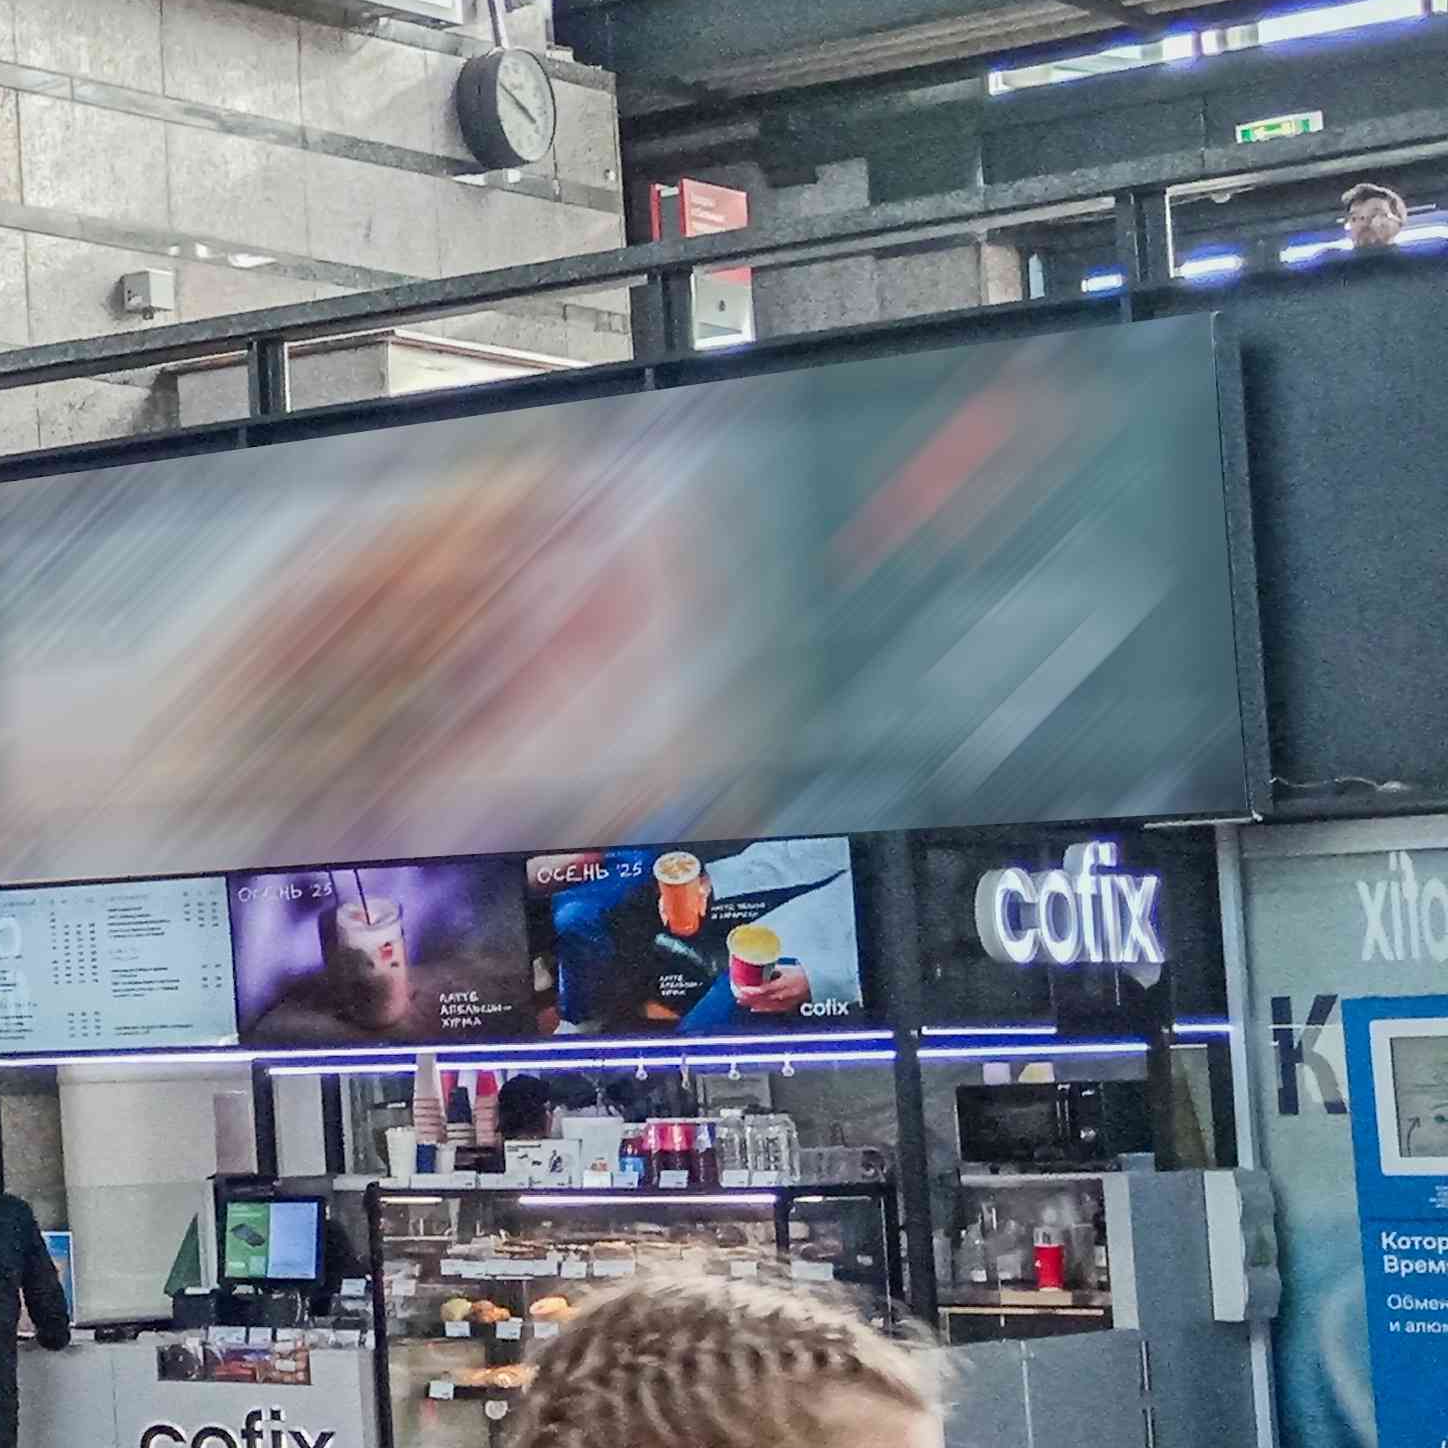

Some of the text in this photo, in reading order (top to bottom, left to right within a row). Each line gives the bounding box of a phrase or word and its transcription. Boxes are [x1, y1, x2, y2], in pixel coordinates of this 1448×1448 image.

[990, 841, 1165, 964] cofix
[801, 999, 849, 1017] cofix
[1383, 1254, 1448, 1278] Врем
